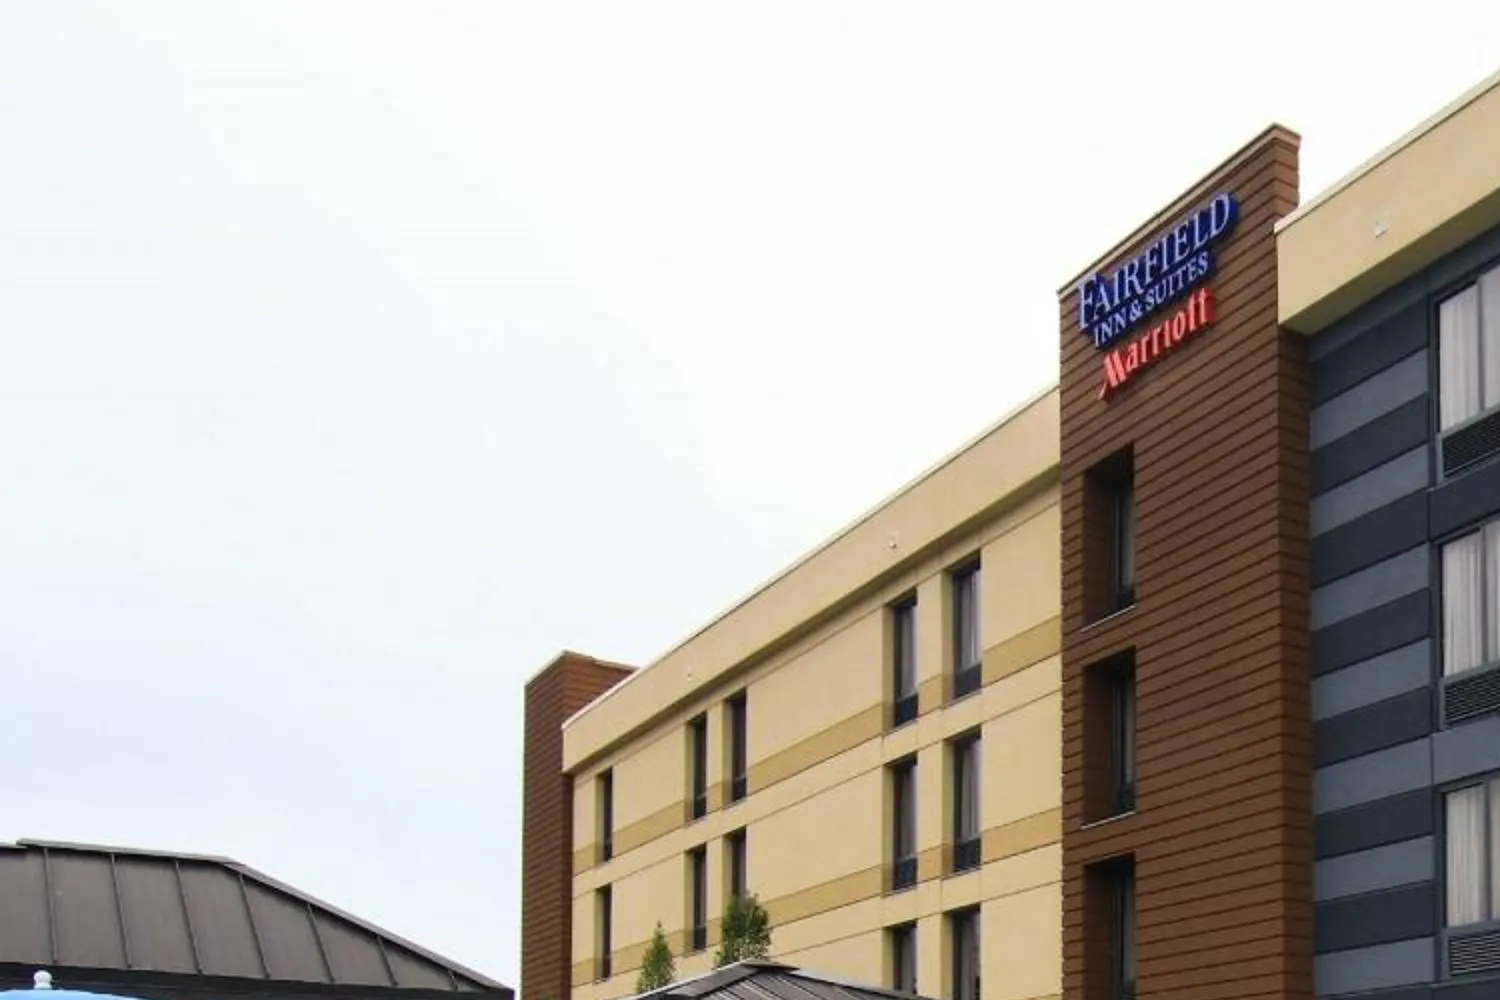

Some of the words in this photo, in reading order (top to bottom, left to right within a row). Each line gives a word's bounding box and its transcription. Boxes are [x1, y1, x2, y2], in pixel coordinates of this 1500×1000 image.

[1078, 191, 1233, 331] FAIRFIELD
[1094, 306, 1127, 348] INN
[1129, 300, 1143, 322] &
[1145, 251, 1209, 311] SUITES
[1099, 287, 1210, 401] Marriott
